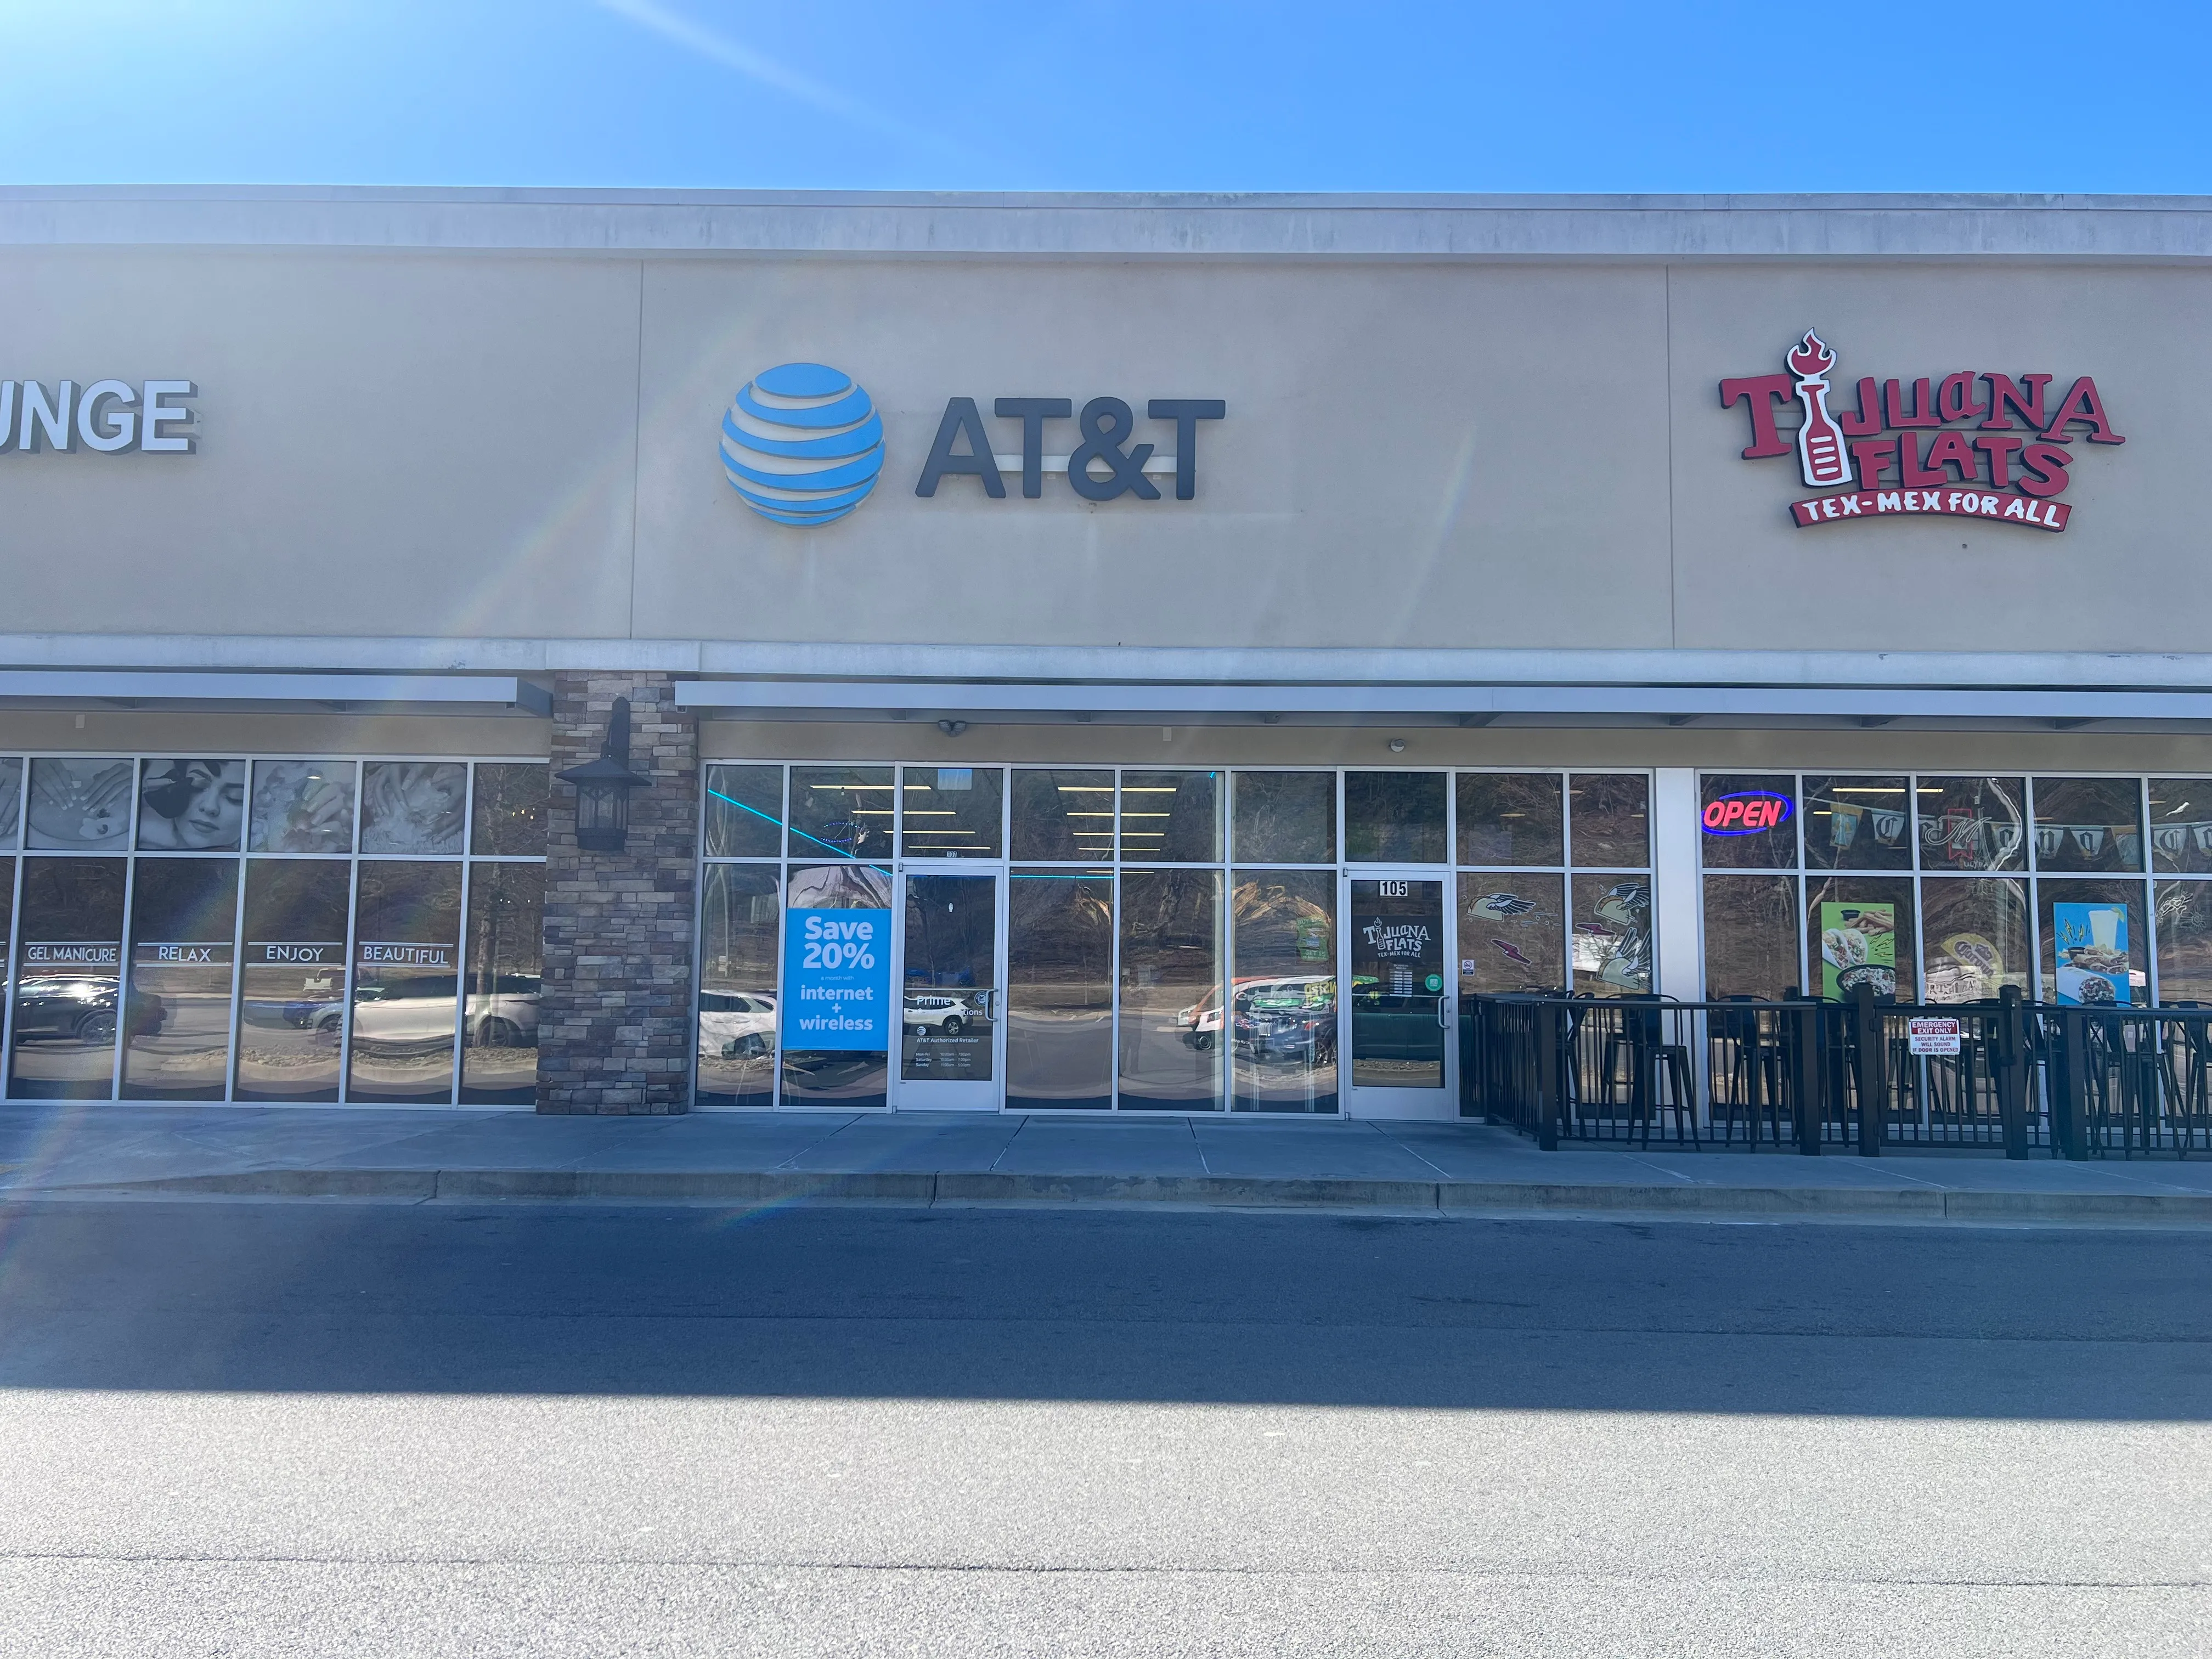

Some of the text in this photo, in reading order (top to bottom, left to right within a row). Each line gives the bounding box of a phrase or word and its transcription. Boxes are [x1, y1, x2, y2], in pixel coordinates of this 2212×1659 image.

[915, 396, 1226, 501] AT&T
[1851, 431, 2074, 498] FLATS
[1802, 491, 2061, 528] TEX-MEX FOR ALL
[1703, 800, 1781, 827] OPEN
[1382, 882, 1407, 895] 105
[804, 916, 873, 940] Save
[1386, 938, 1423, 952] FLATS
[28, 946, 116, 962] GEL MANICURE
[159, 946, 211, 962] RELAX
[266, 946, 324, 962] ENJOY
[363, 946, 448, 964] BEAUTIFUL
[803, 942, 875, 969] 20%
[800, 984, 873, 1000] internet
[832, 1003, 842, 1013] +
[917, 995, 951, 1006] Prime
[799, 1014, 873, 1030] wireless
